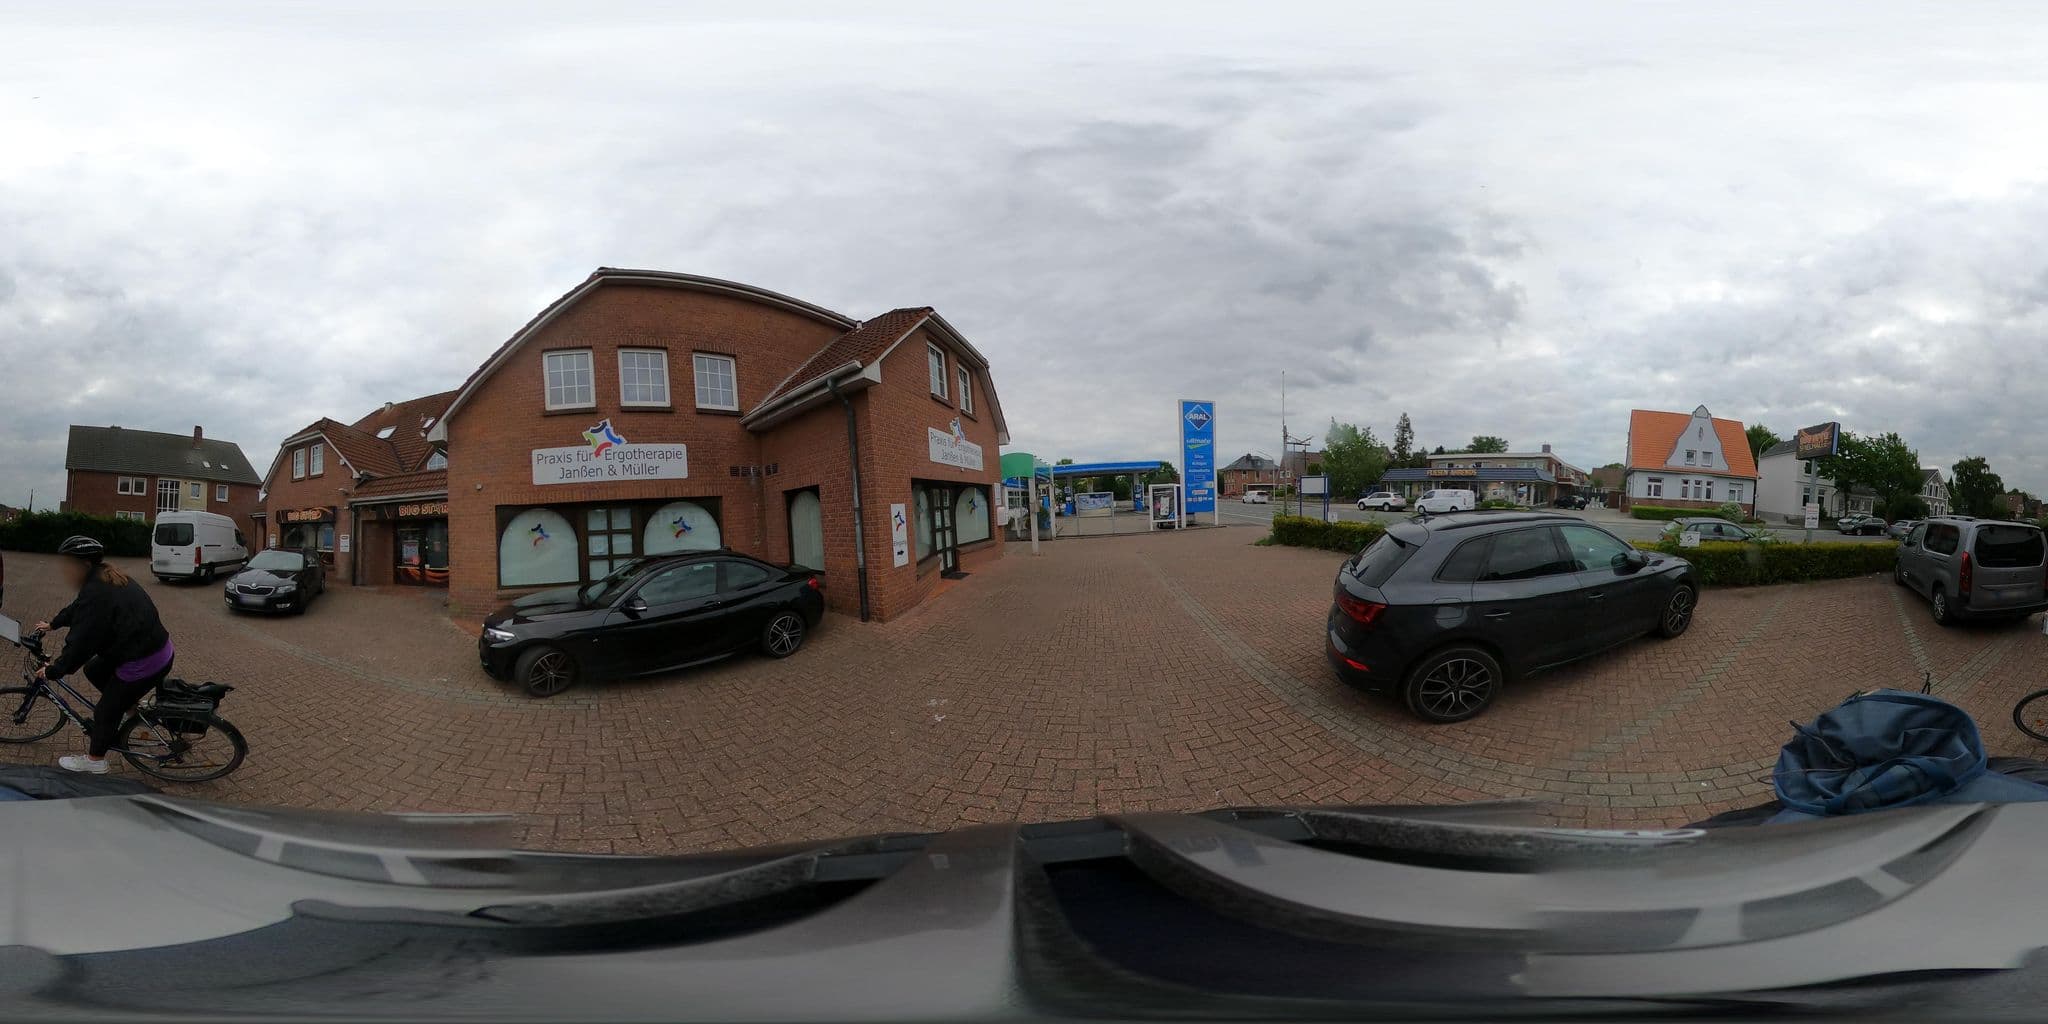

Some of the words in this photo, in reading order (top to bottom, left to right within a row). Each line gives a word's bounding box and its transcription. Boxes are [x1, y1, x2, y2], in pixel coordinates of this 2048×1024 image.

[536, 453, 573, 465] Praxis
[576, 450, 594, 462] für
[604, 447, 683, 464] Ergotherapie
[559, 465, 603, 480] Janßen
[607, 465, 618, 477] &
[622, 463, 660, 477] Müller
[399, 504, 420, 517] BIG
